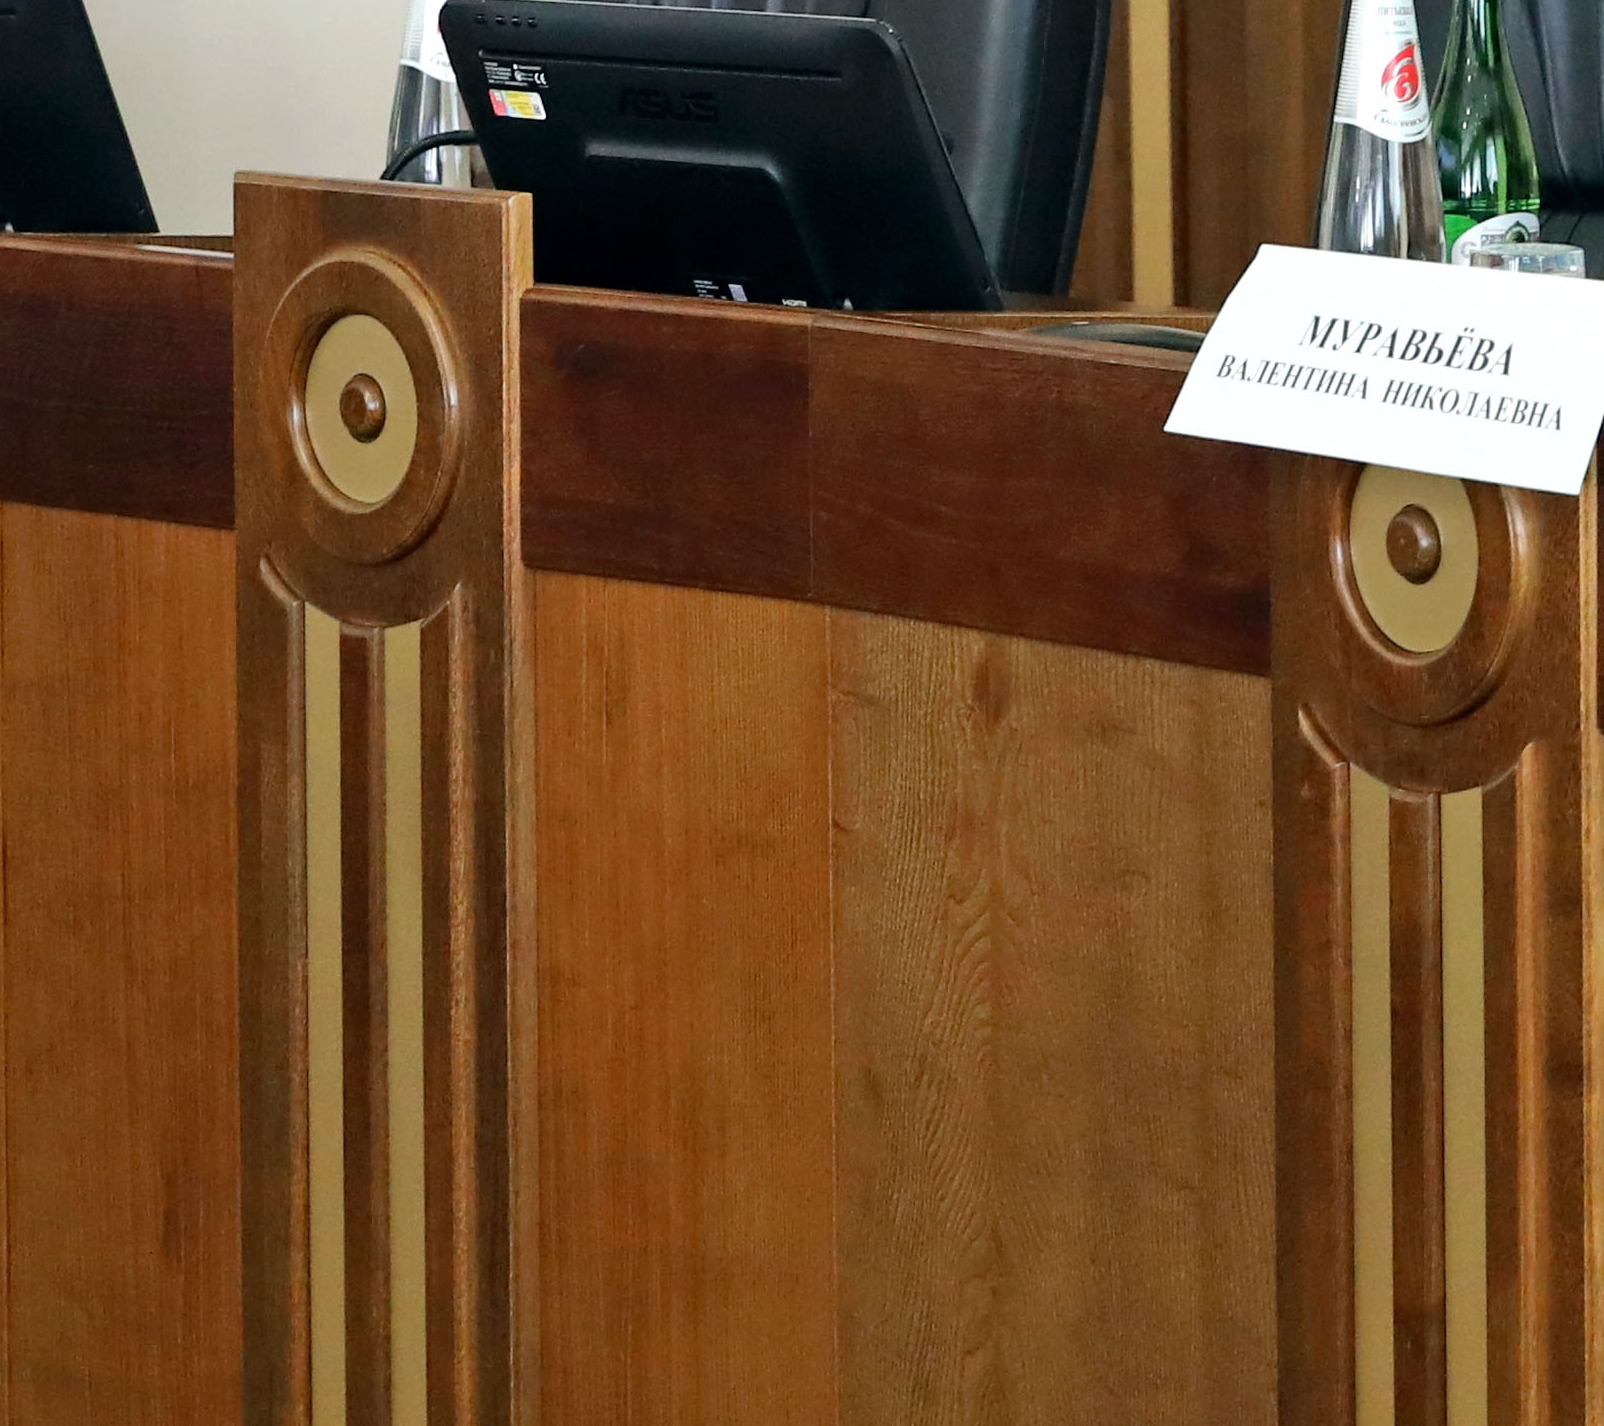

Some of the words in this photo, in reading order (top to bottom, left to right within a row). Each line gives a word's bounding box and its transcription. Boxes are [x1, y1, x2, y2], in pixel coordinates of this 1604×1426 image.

[1298, 314, 1515, 377] МУРАВЬЁВА
[1216, 353, 1369, 400] ВАЛЕНТИНА
[1381, 378, 1563, 431] НИКОЛАЕВНА
